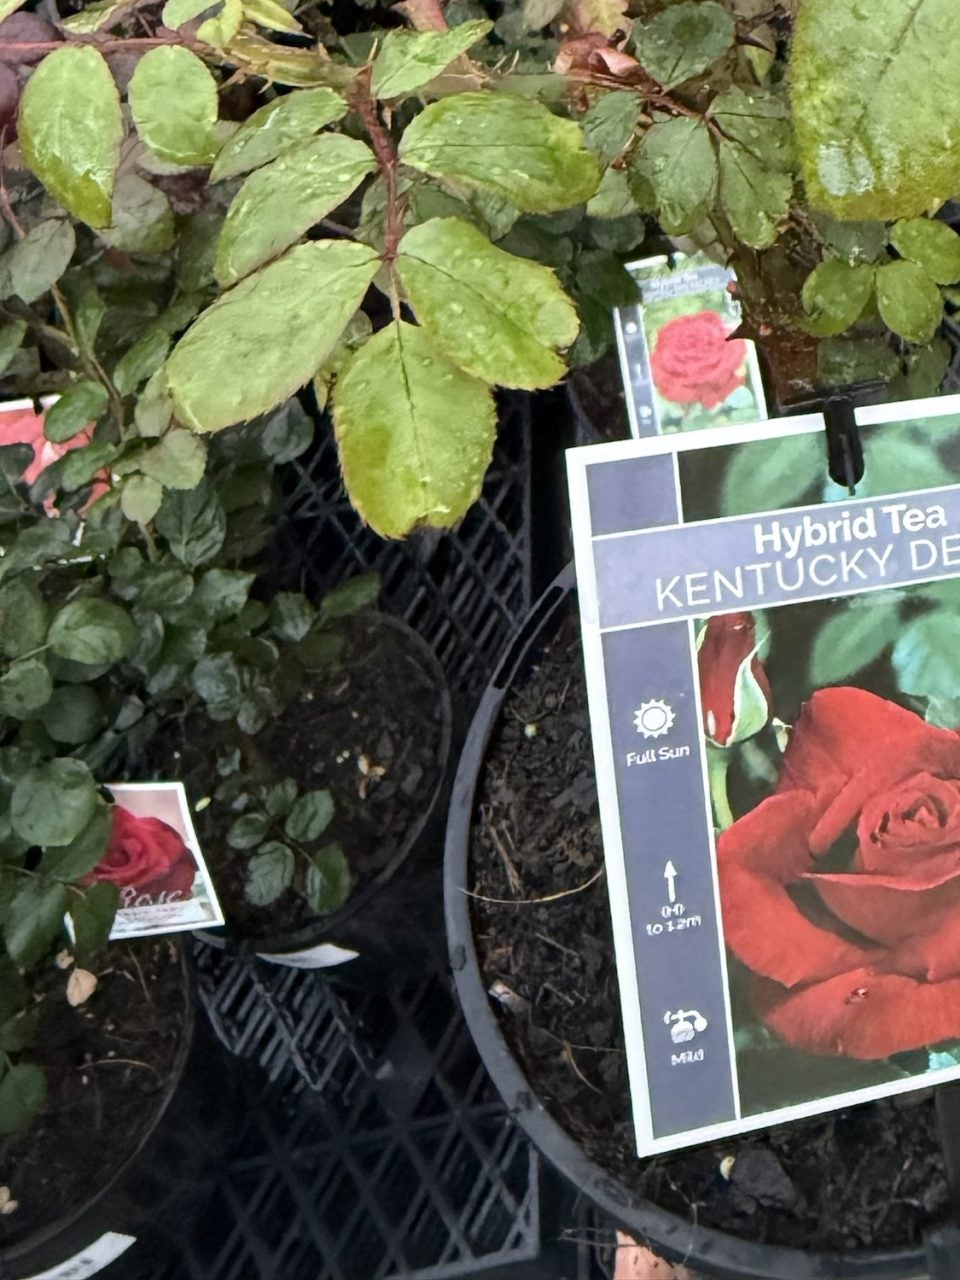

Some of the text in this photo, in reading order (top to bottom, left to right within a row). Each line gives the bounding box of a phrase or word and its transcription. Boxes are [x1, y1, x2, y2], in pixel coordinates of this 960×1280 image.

[754, 503, 948, 559] Hybrid Tea
[655, 543, 894, 612] KENTUCKY
[626, 745, 690, 768] Full Sun
